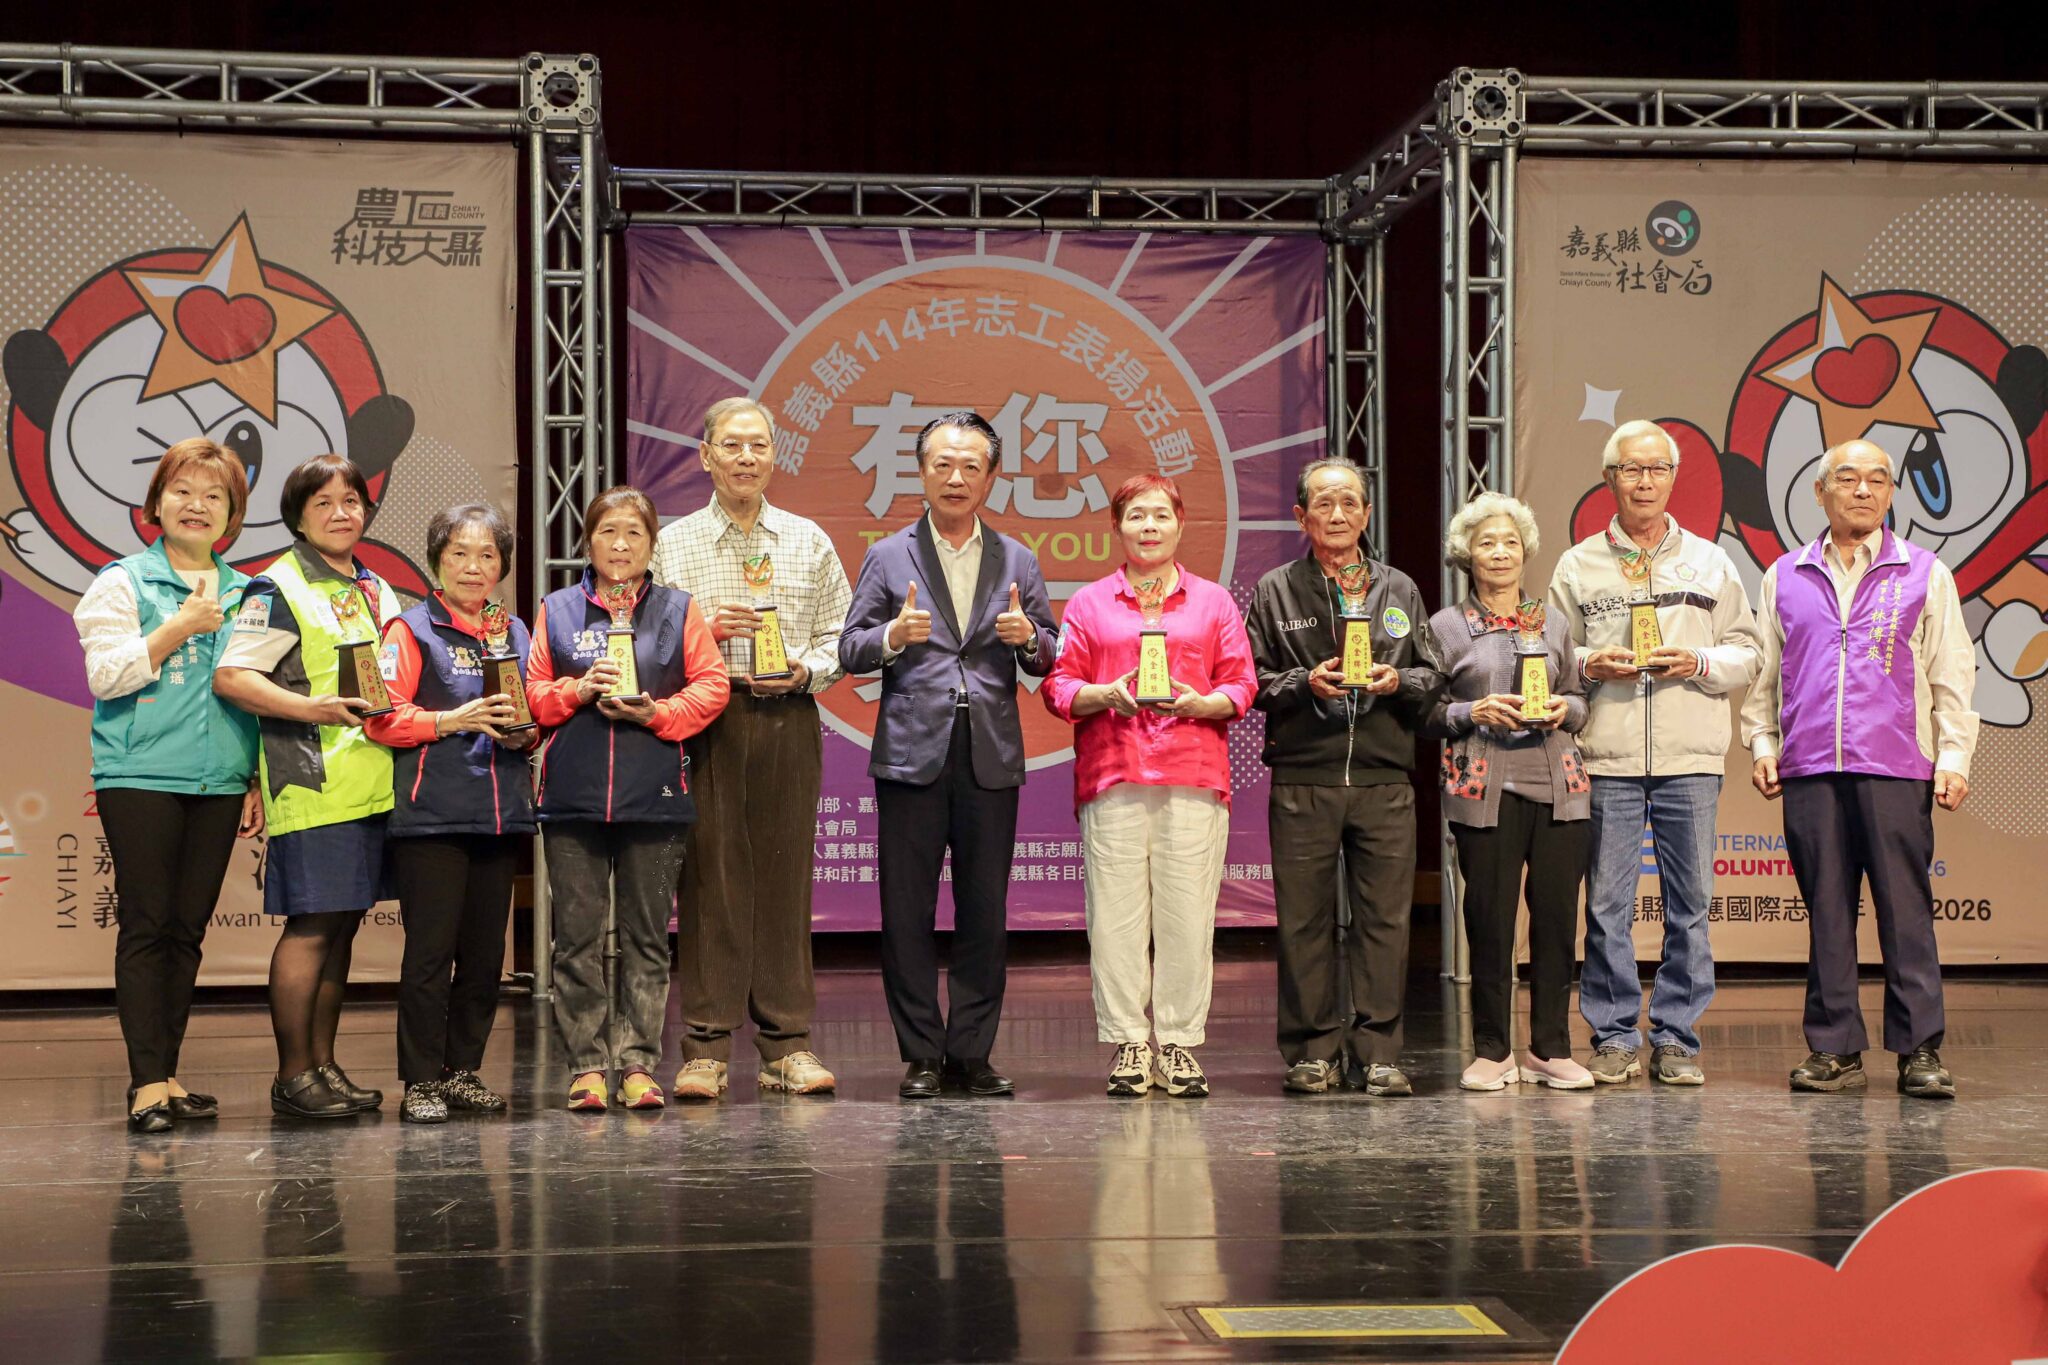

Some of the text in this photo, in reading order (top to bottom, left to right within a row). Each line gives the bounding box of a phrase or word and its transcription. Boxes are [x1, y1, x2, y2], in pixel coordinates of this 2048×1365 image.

[331, 230, 484, 267] 科技大縣
[1560, 225, 1642, 266] 嘉義縣
[1559, 278, 1612, 289] Chiayi County
[1616, 259, 1712, 295] 社會局
[1021, 532, 1111, 562] YOU
[1278, 616, 1318, 632] TAIBAO
[169, 647, 185, 685] 翠瑤
[817, 797, 878, 814] 部、嘉
[57, 834, 78, 928] CHIAYI
[1933, 899, 1991, 921] 2026
